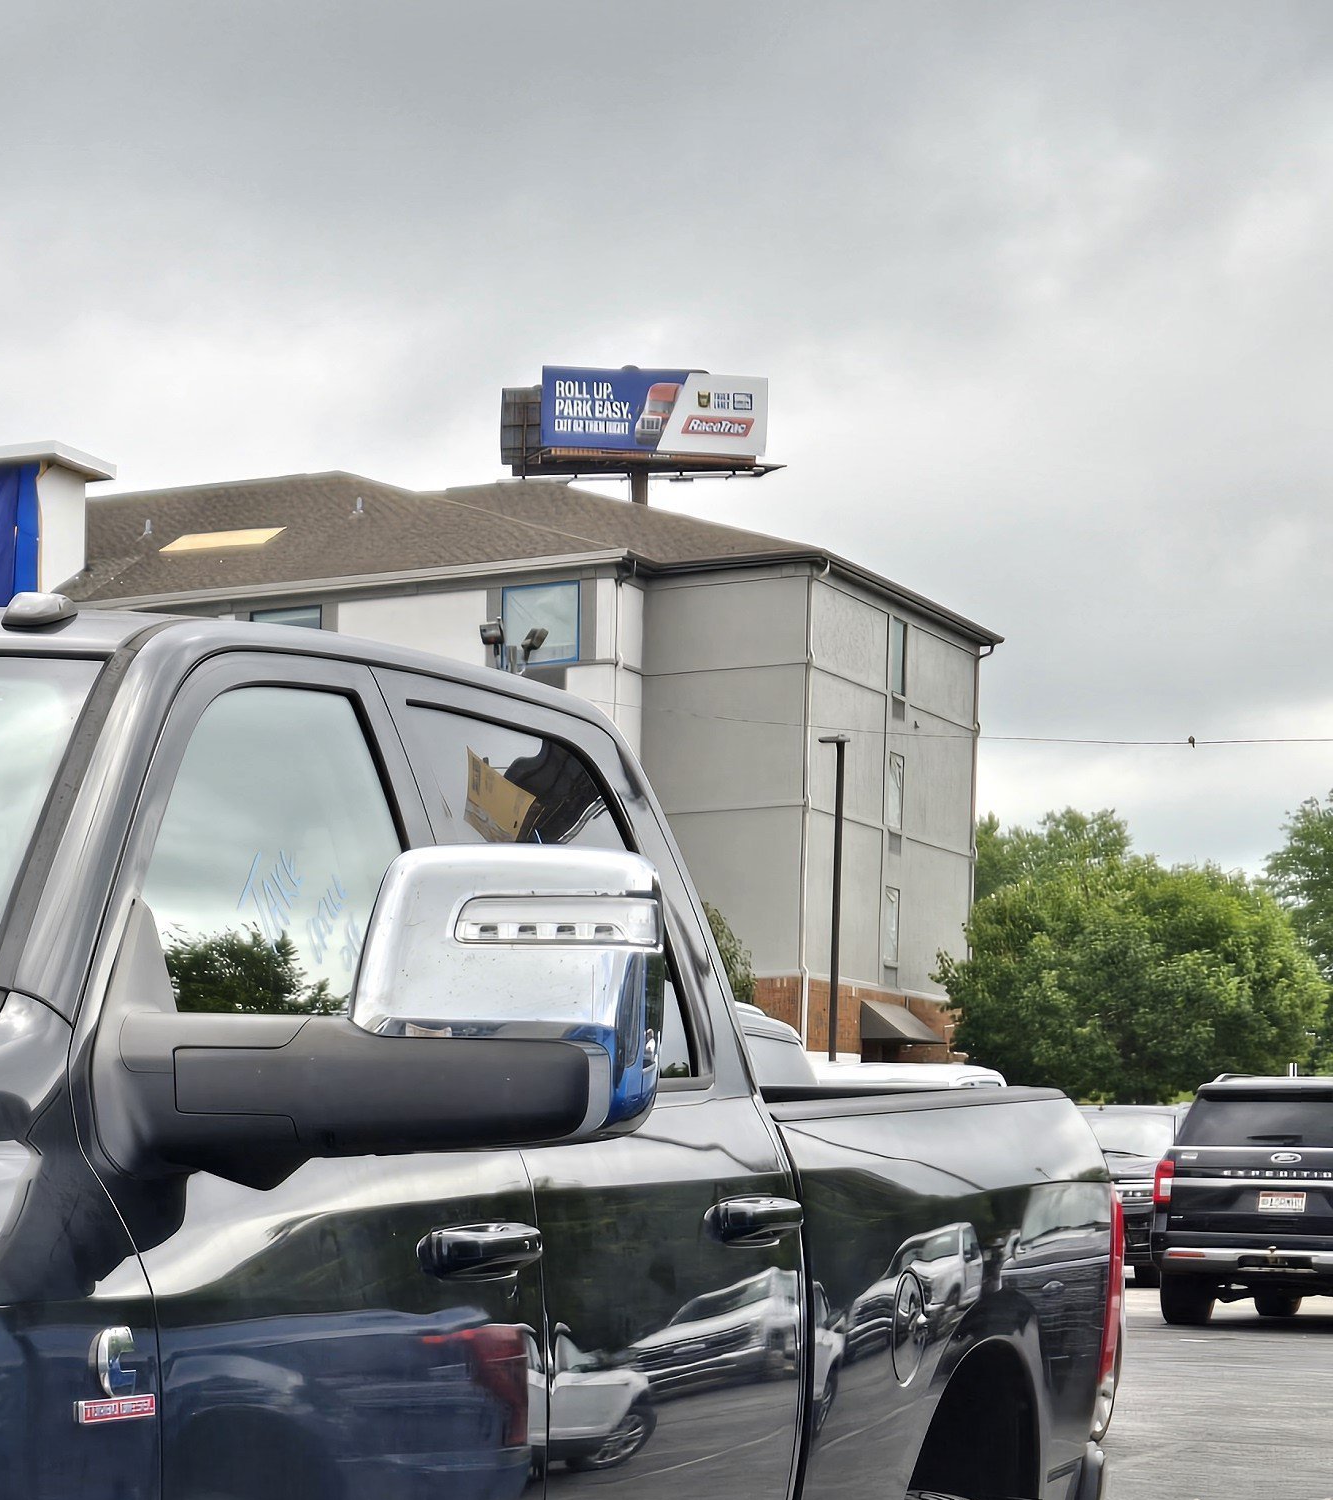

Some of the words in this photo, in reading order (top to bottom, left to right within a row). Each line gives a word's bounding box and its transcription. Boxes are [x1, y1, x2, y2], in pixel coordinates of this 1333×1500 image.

[555, 380, 590, 399] ROLL
[555, 399, 593, 418] PARK
[594, 400, 632, 420] EASY.
[1222, 1170, 1332, 1178] EXPEDITIO
